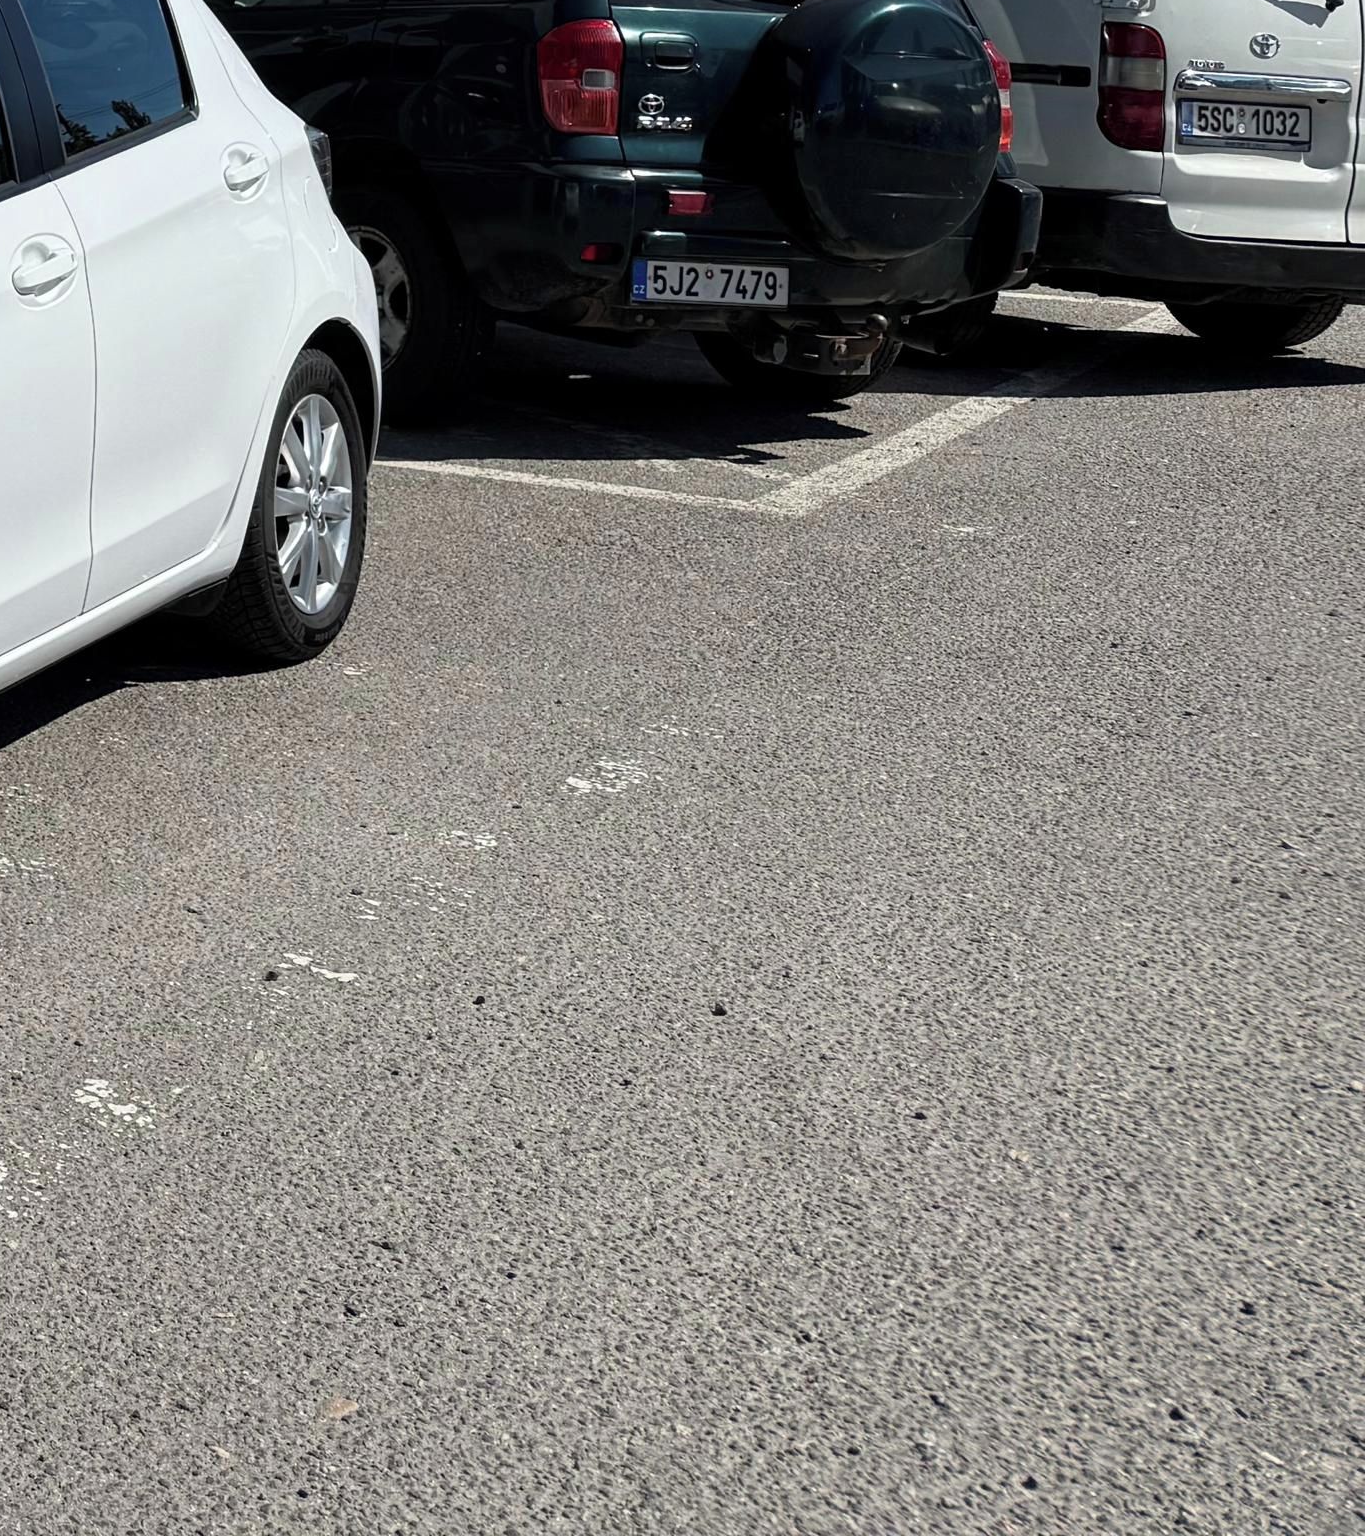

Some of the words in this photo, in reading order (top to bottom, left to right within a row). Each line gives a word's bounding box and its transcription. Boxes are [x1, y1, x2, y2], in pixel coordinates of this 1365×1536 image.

[1197, 105, 1234, 133] 5SC
[1252, 109, 1300, 137] 1032
[633, 285, 645, 294] CZ
[653, 265, 699, 297] 5J2
[720, 268, 777, 301] 7479
